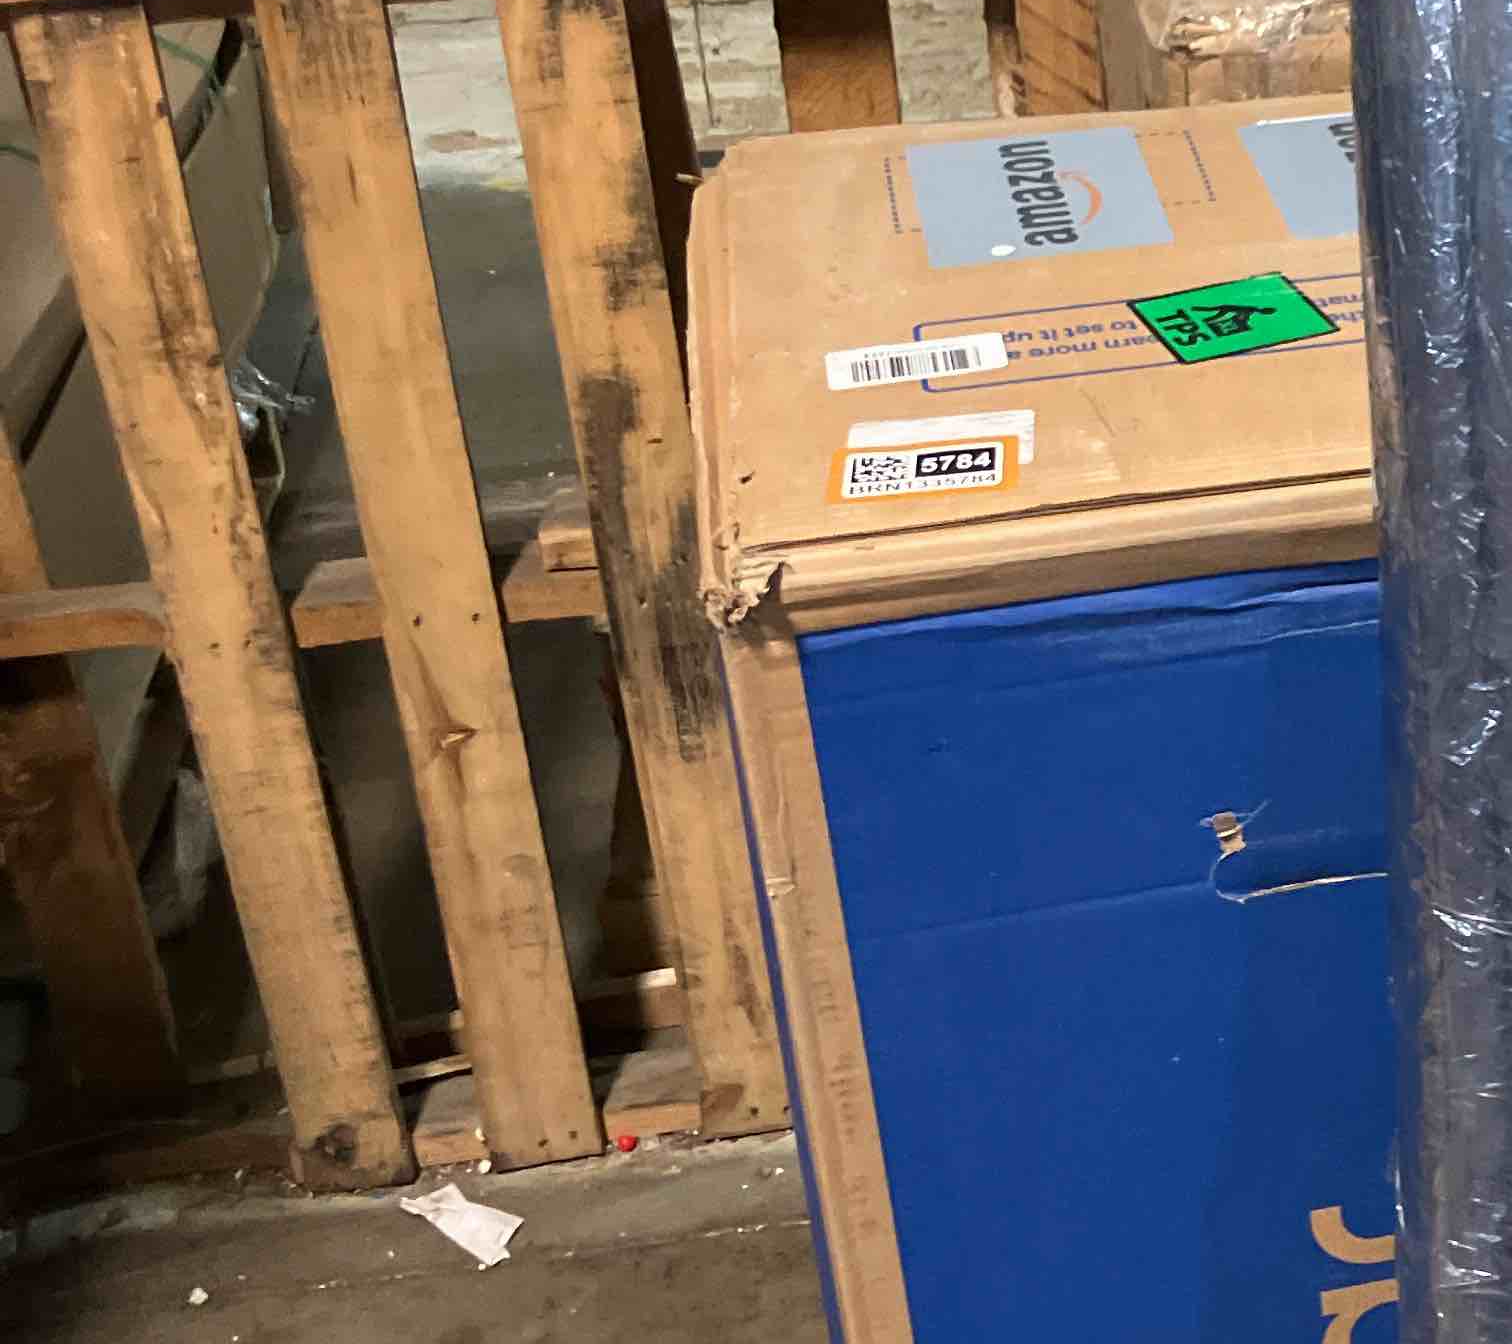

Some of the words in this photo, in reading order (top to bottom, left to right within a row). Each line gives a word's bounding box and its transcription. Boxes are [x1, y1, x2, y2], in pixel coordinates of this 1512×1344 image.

[998, 139, 1080, 247] amazon
[1062, 323, 1104, 338] set
[1110, 319, 1137, 332] to
[1154, 308, 1212, 347] TPS
[1039, 329, 1057, 342] it
[1029, 341, 1097, 358] more
[919, 450, 993, 474] 5784
